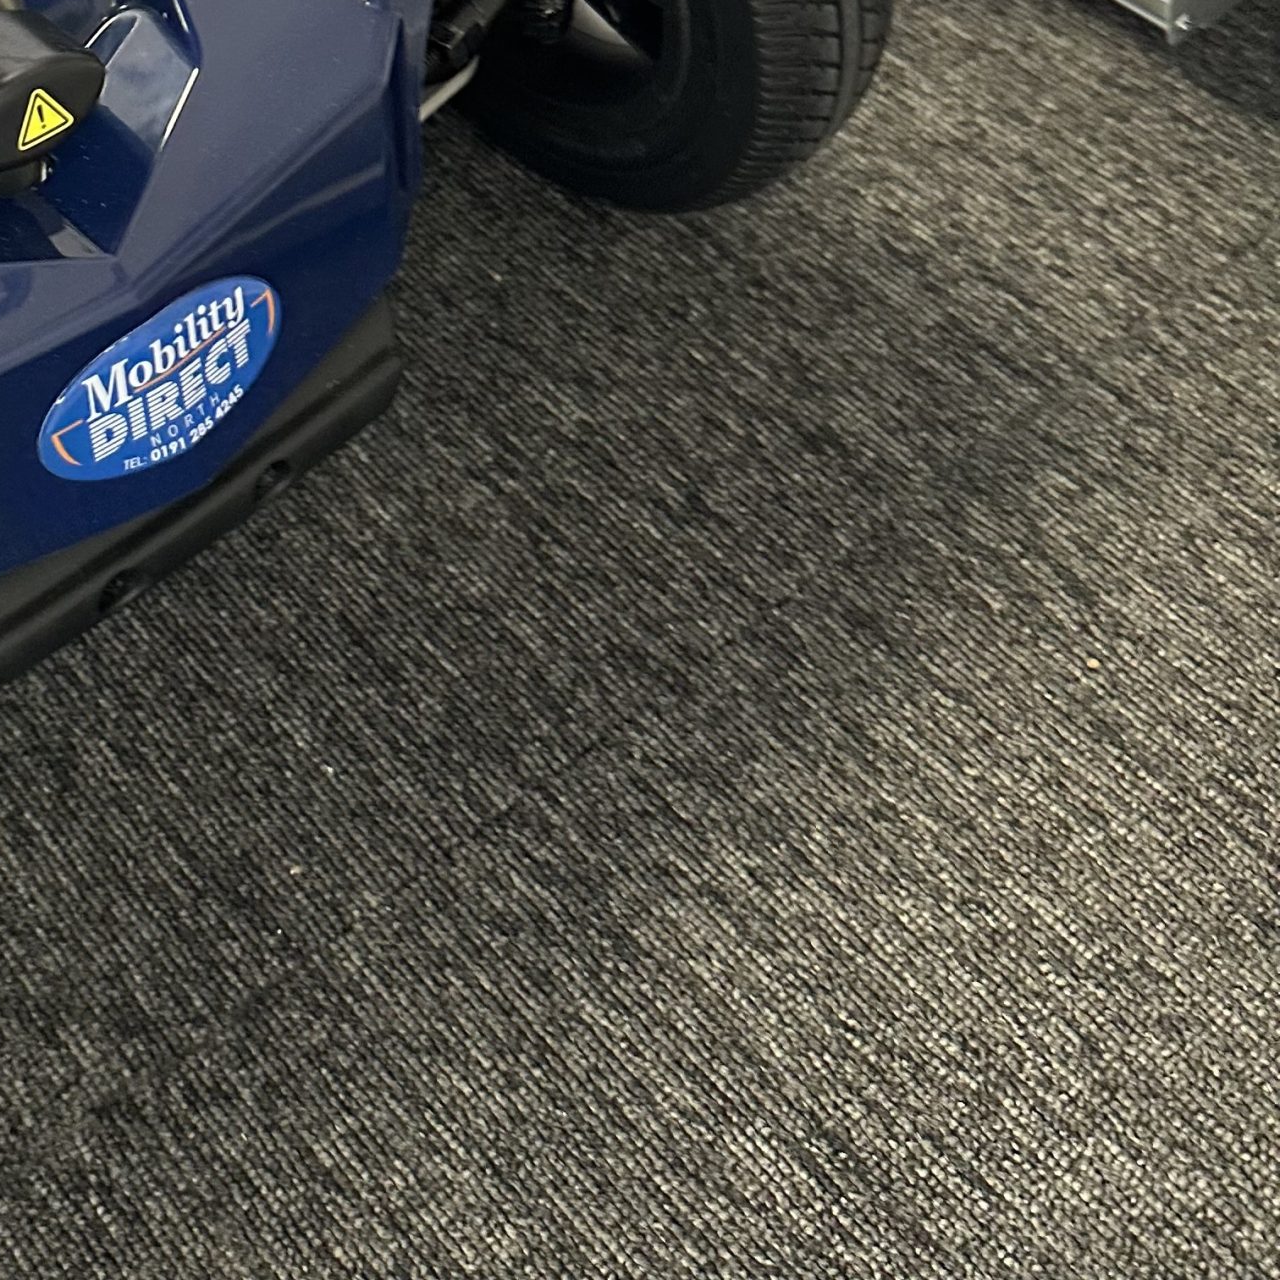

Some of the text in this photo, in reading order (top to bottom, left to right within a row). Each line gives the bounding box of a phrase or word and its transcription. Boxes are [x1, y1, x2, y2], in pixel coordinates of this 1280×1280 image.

[82, 286, 245, 422] Mobility
[88, 318, 251, 462] DIRECT
[150, 436, 187, 461] 0191
[189, 416, 214, 443] 285
[215, 384, 244, 420] 4245
